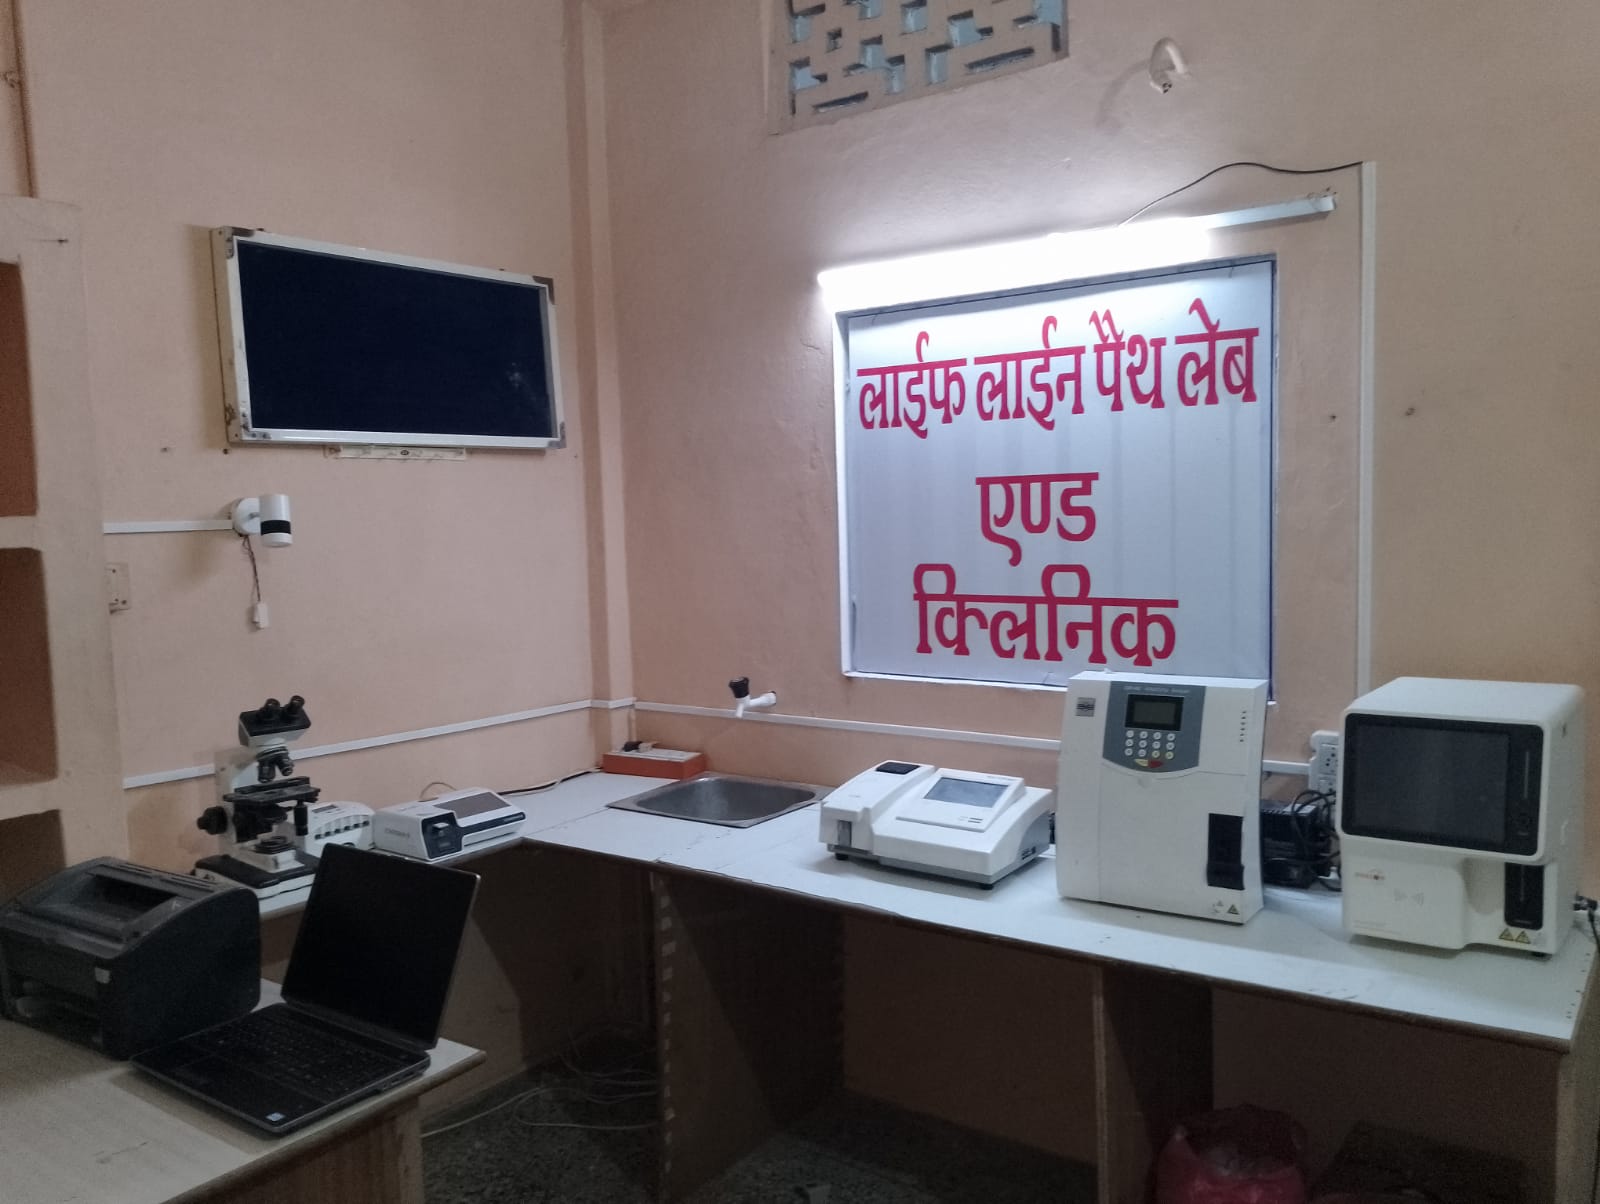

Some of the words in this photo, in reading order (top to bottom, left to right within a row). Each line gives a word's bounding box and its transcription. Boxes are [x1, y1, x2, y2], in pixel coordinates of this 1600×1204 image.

[856, 331, 967, 439] लाईफ
[974, 316, 1086, 431] लाईन
[1089, 310, 1166, 412] पैथ
[1175, 298, 1259, 407] लेब
[976, 472, 1099, 566] एण्ड
[913, 563, 1179, 666] क्लिनिक
